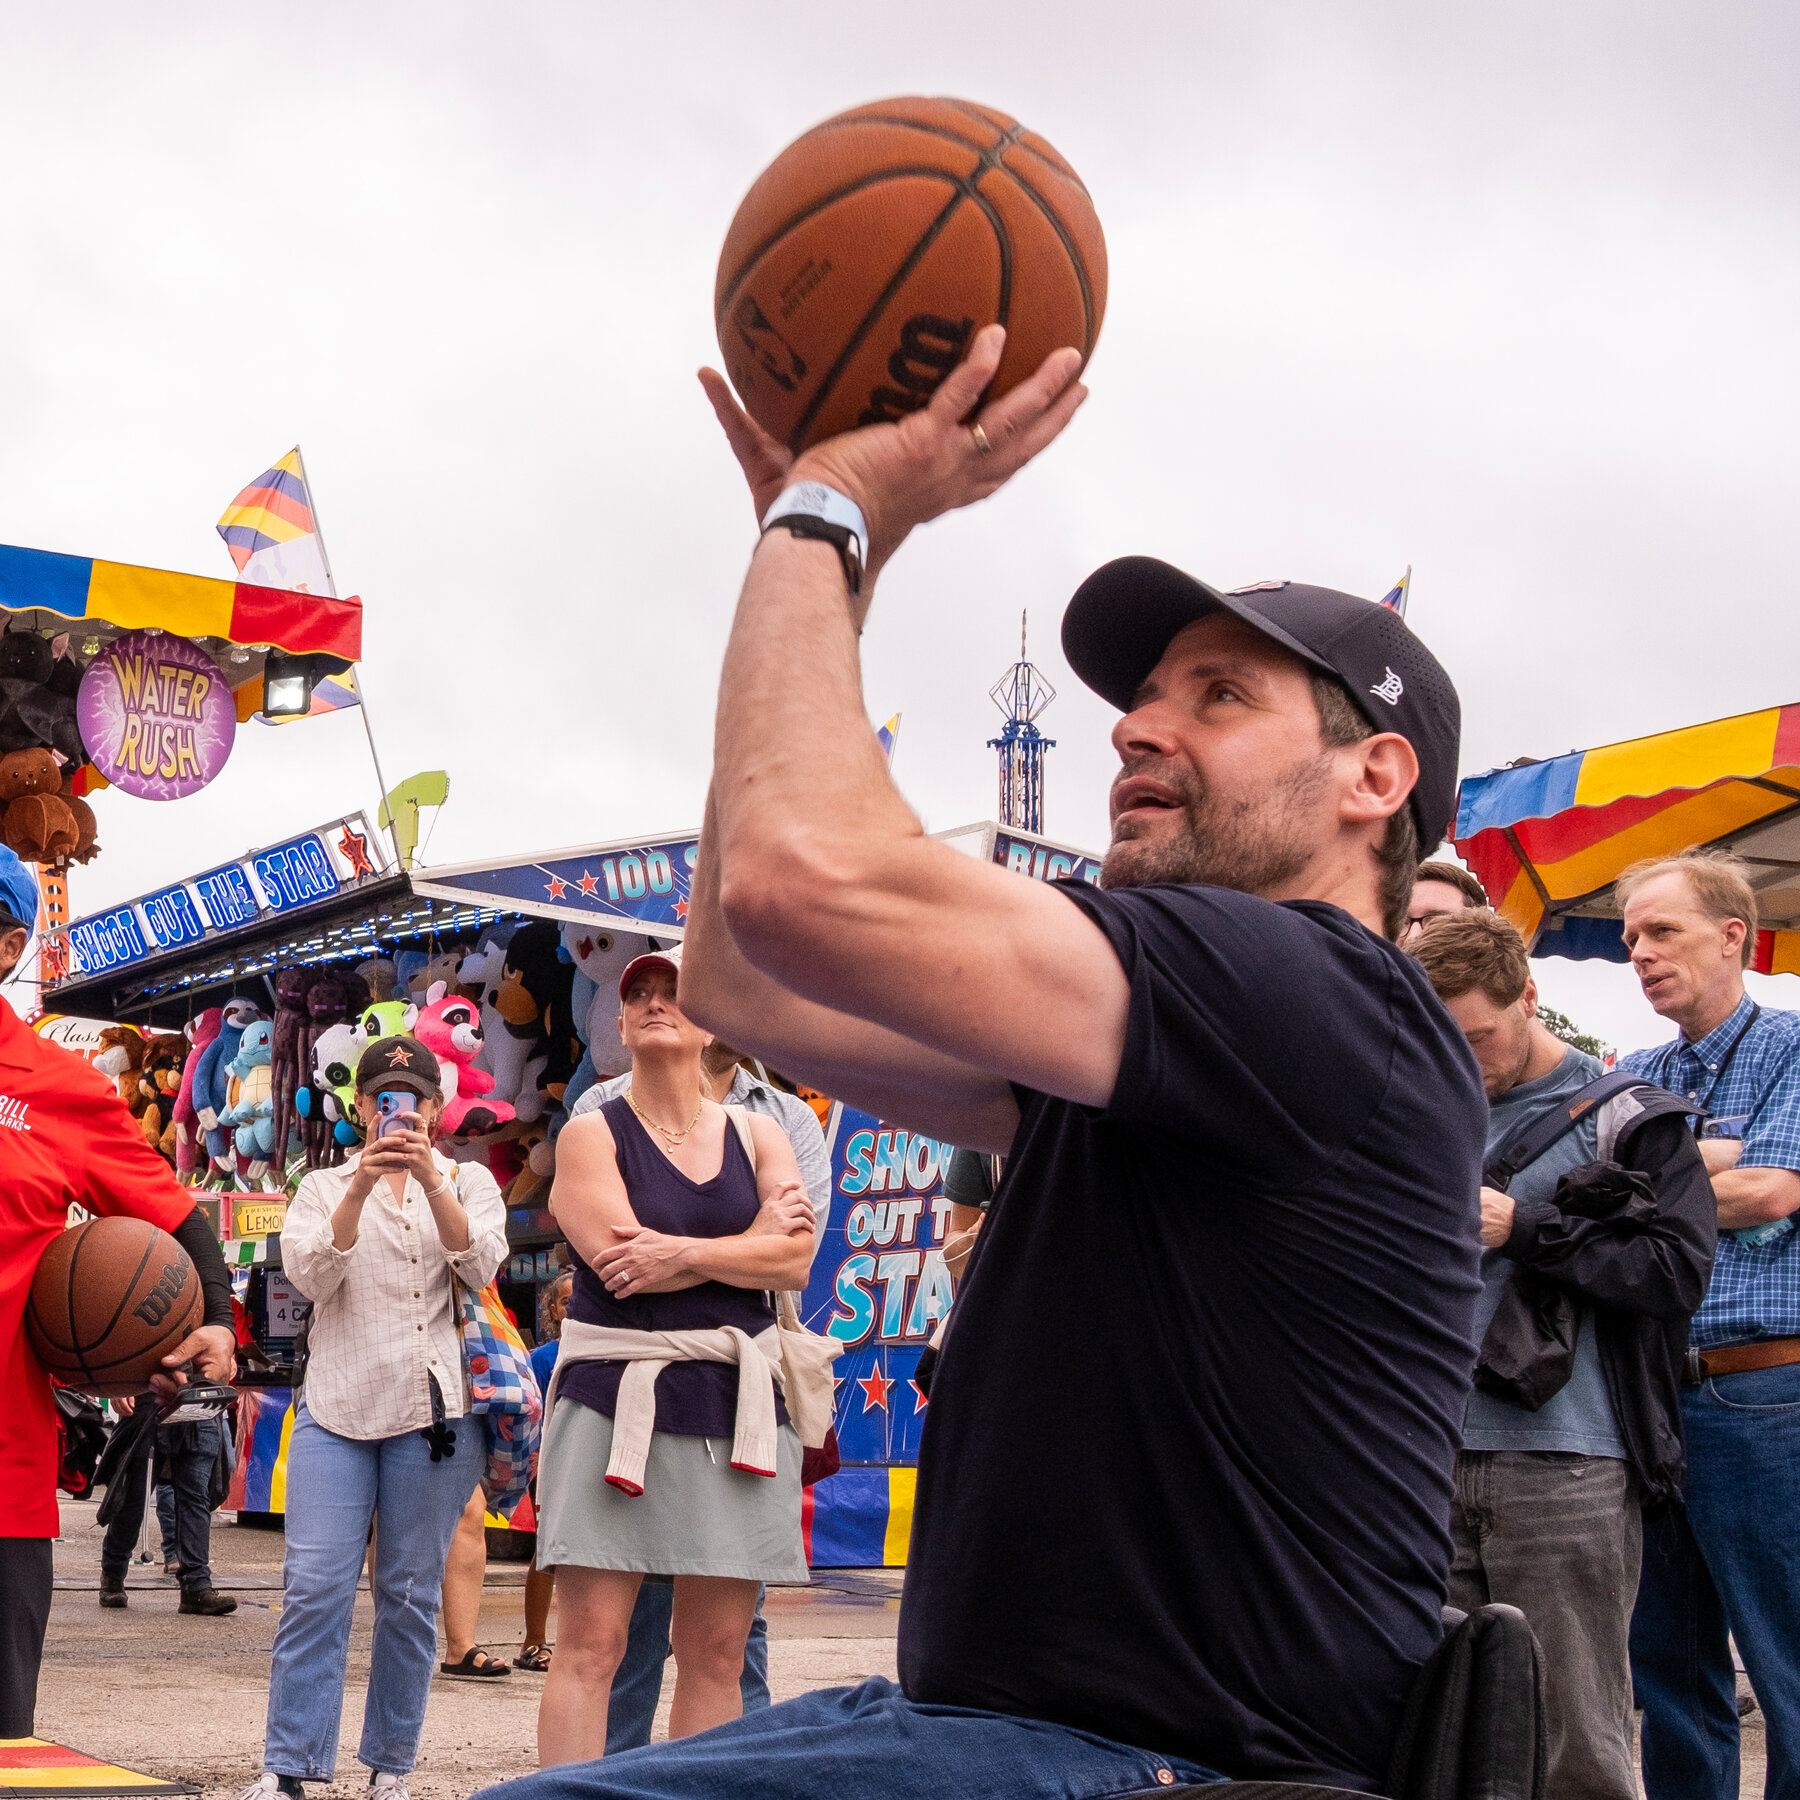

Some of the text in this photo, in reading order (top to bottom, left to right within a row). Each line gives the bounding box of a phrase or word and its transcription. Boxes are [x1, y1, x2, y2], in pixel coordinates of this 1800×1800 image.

[110, 653, 210, 720] WATER
[116, 713, 201, 780] RUSH
[69, 839, 336, 973] SHOOT OUT THE STAR
[602, 850, 676, 902] 100
[847, 1197, 923, 1249] OUT
[132, 1246, 190, 1327] Wilso
[277, 1308, 287, 1321] 4
